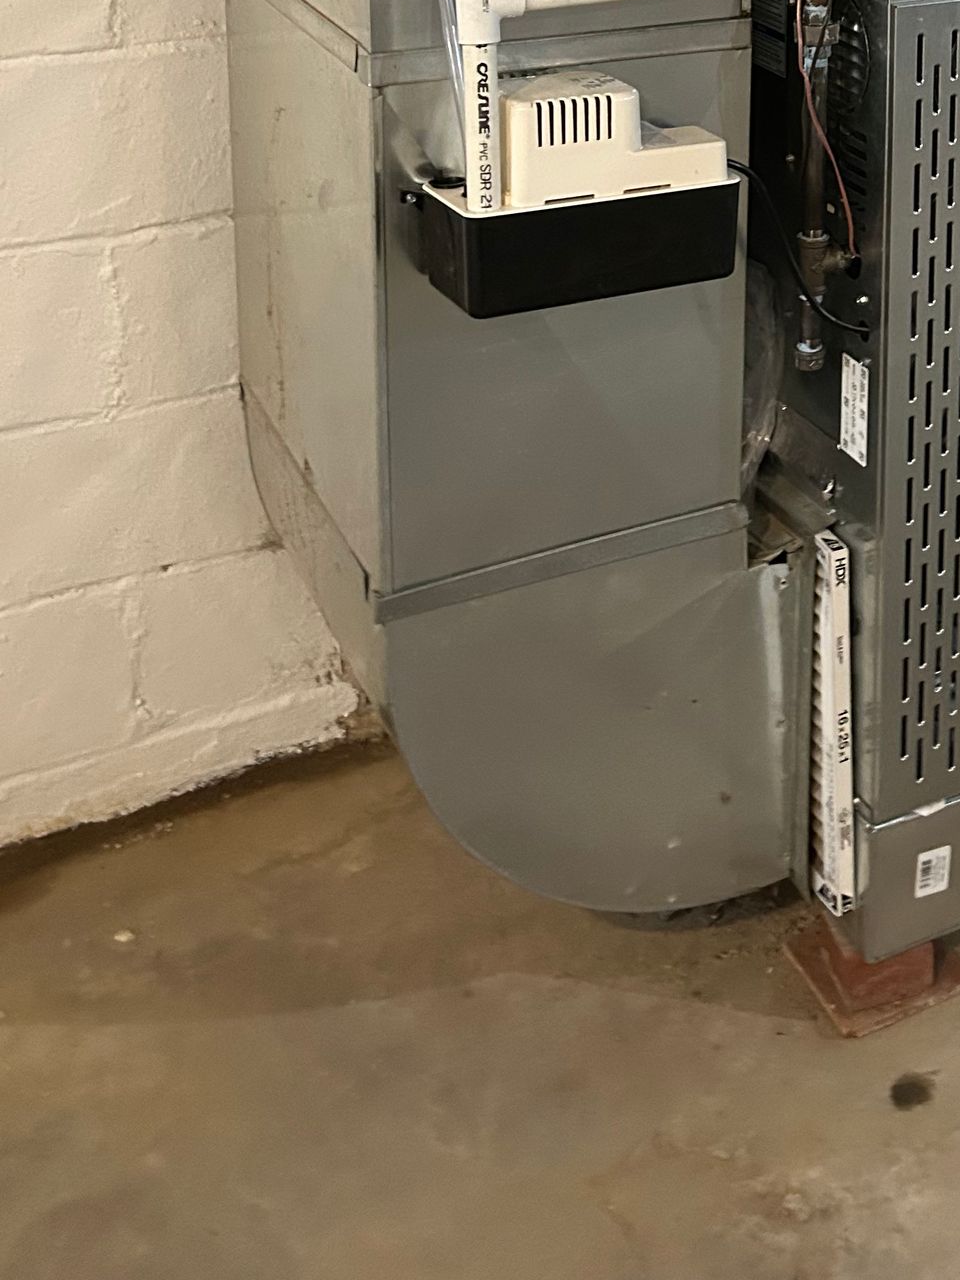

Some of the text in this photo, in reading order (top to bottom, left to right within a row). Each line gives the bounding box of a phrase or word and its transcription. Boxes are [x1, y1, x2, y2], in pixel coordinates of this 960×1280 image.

[479, 141, 488, 161] PVC
[480, 164, 492, 191] SDR
[481, 195, 493, 209] 21
[835, 557, 847, 587] HDX
[838, 709, 849, 726] 16
